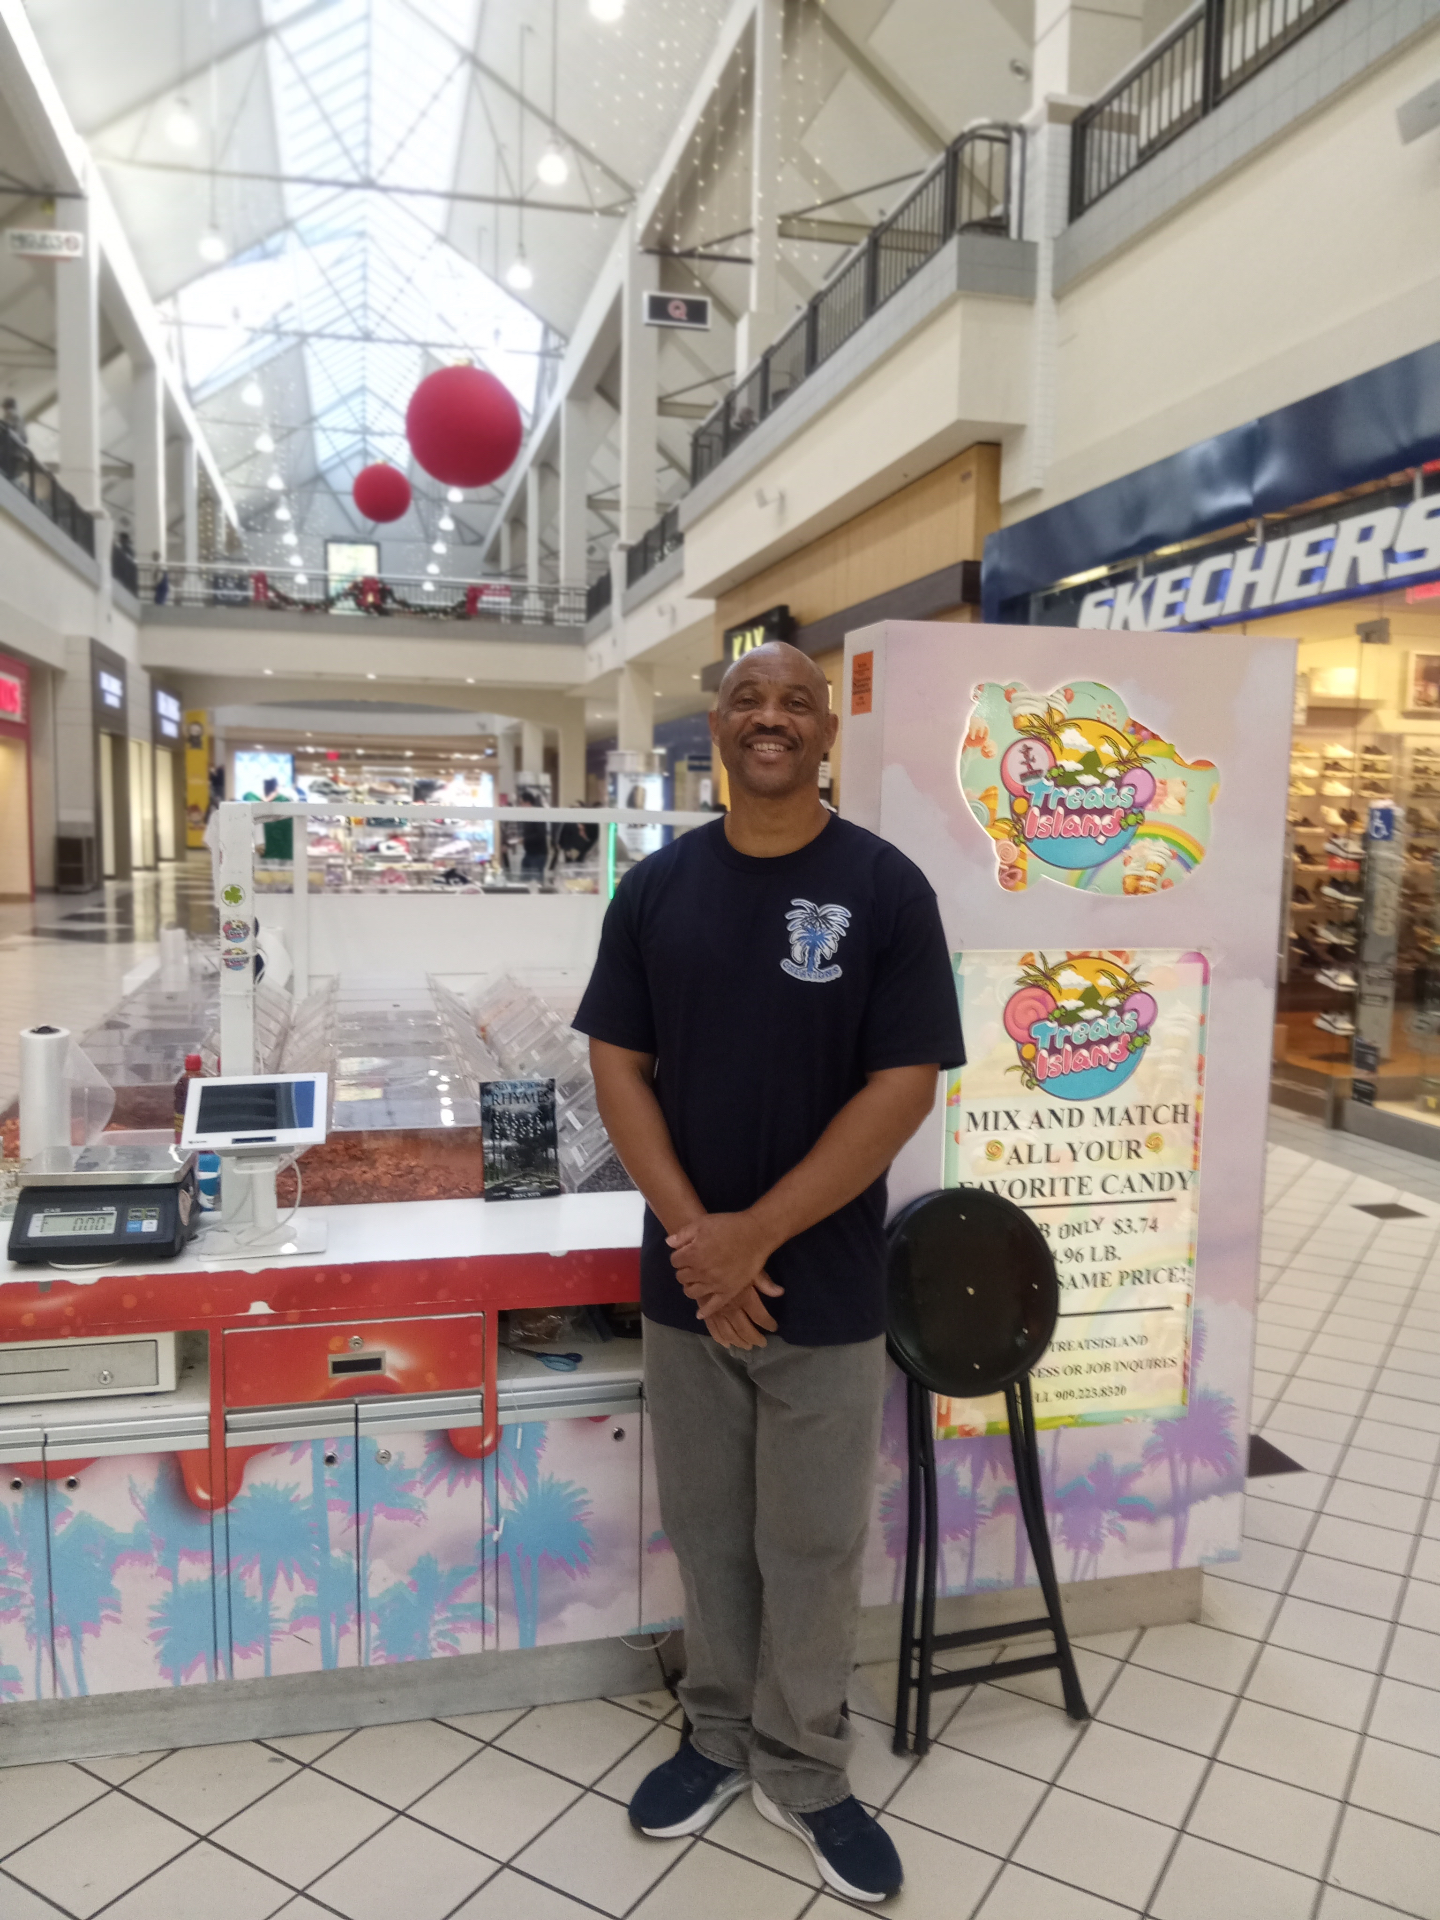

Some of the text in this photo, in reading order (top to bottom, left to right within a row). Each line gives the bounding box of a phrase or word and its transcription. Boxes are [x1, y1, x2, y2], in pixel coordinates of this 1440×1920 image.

[1077, 493, 1440, 631] SKECHERS
[1027, 776, 1135, 809] Treats
[1024, 806, 1125, 839] Island
[1030, 1008, 1138, 1050] Treats
[1035, 1034, 1131, 1080] Island
[491, 1090, 550, 1105] RHYMES
[966, 1102, 1190, 1133] MIX AND MATCH
[1006, 1139, 1144, 1166] ALL YOUR
[1101, 1170, 1195, 1196] CANDY
[1058, 1216, 1105, 1240] ONLY
[1112, 1217, 1159, 1236] $3.74
[1091, 1245, 1122, 1263] LB.
[1057, 1266, 1187, 1291] SAME PRICE!
[1062, 1364, 1082, 1376] OR
[1086, 1362, 1112, 1374] JOB
[1113, 1357, 1178, 1373] INQUIRES
